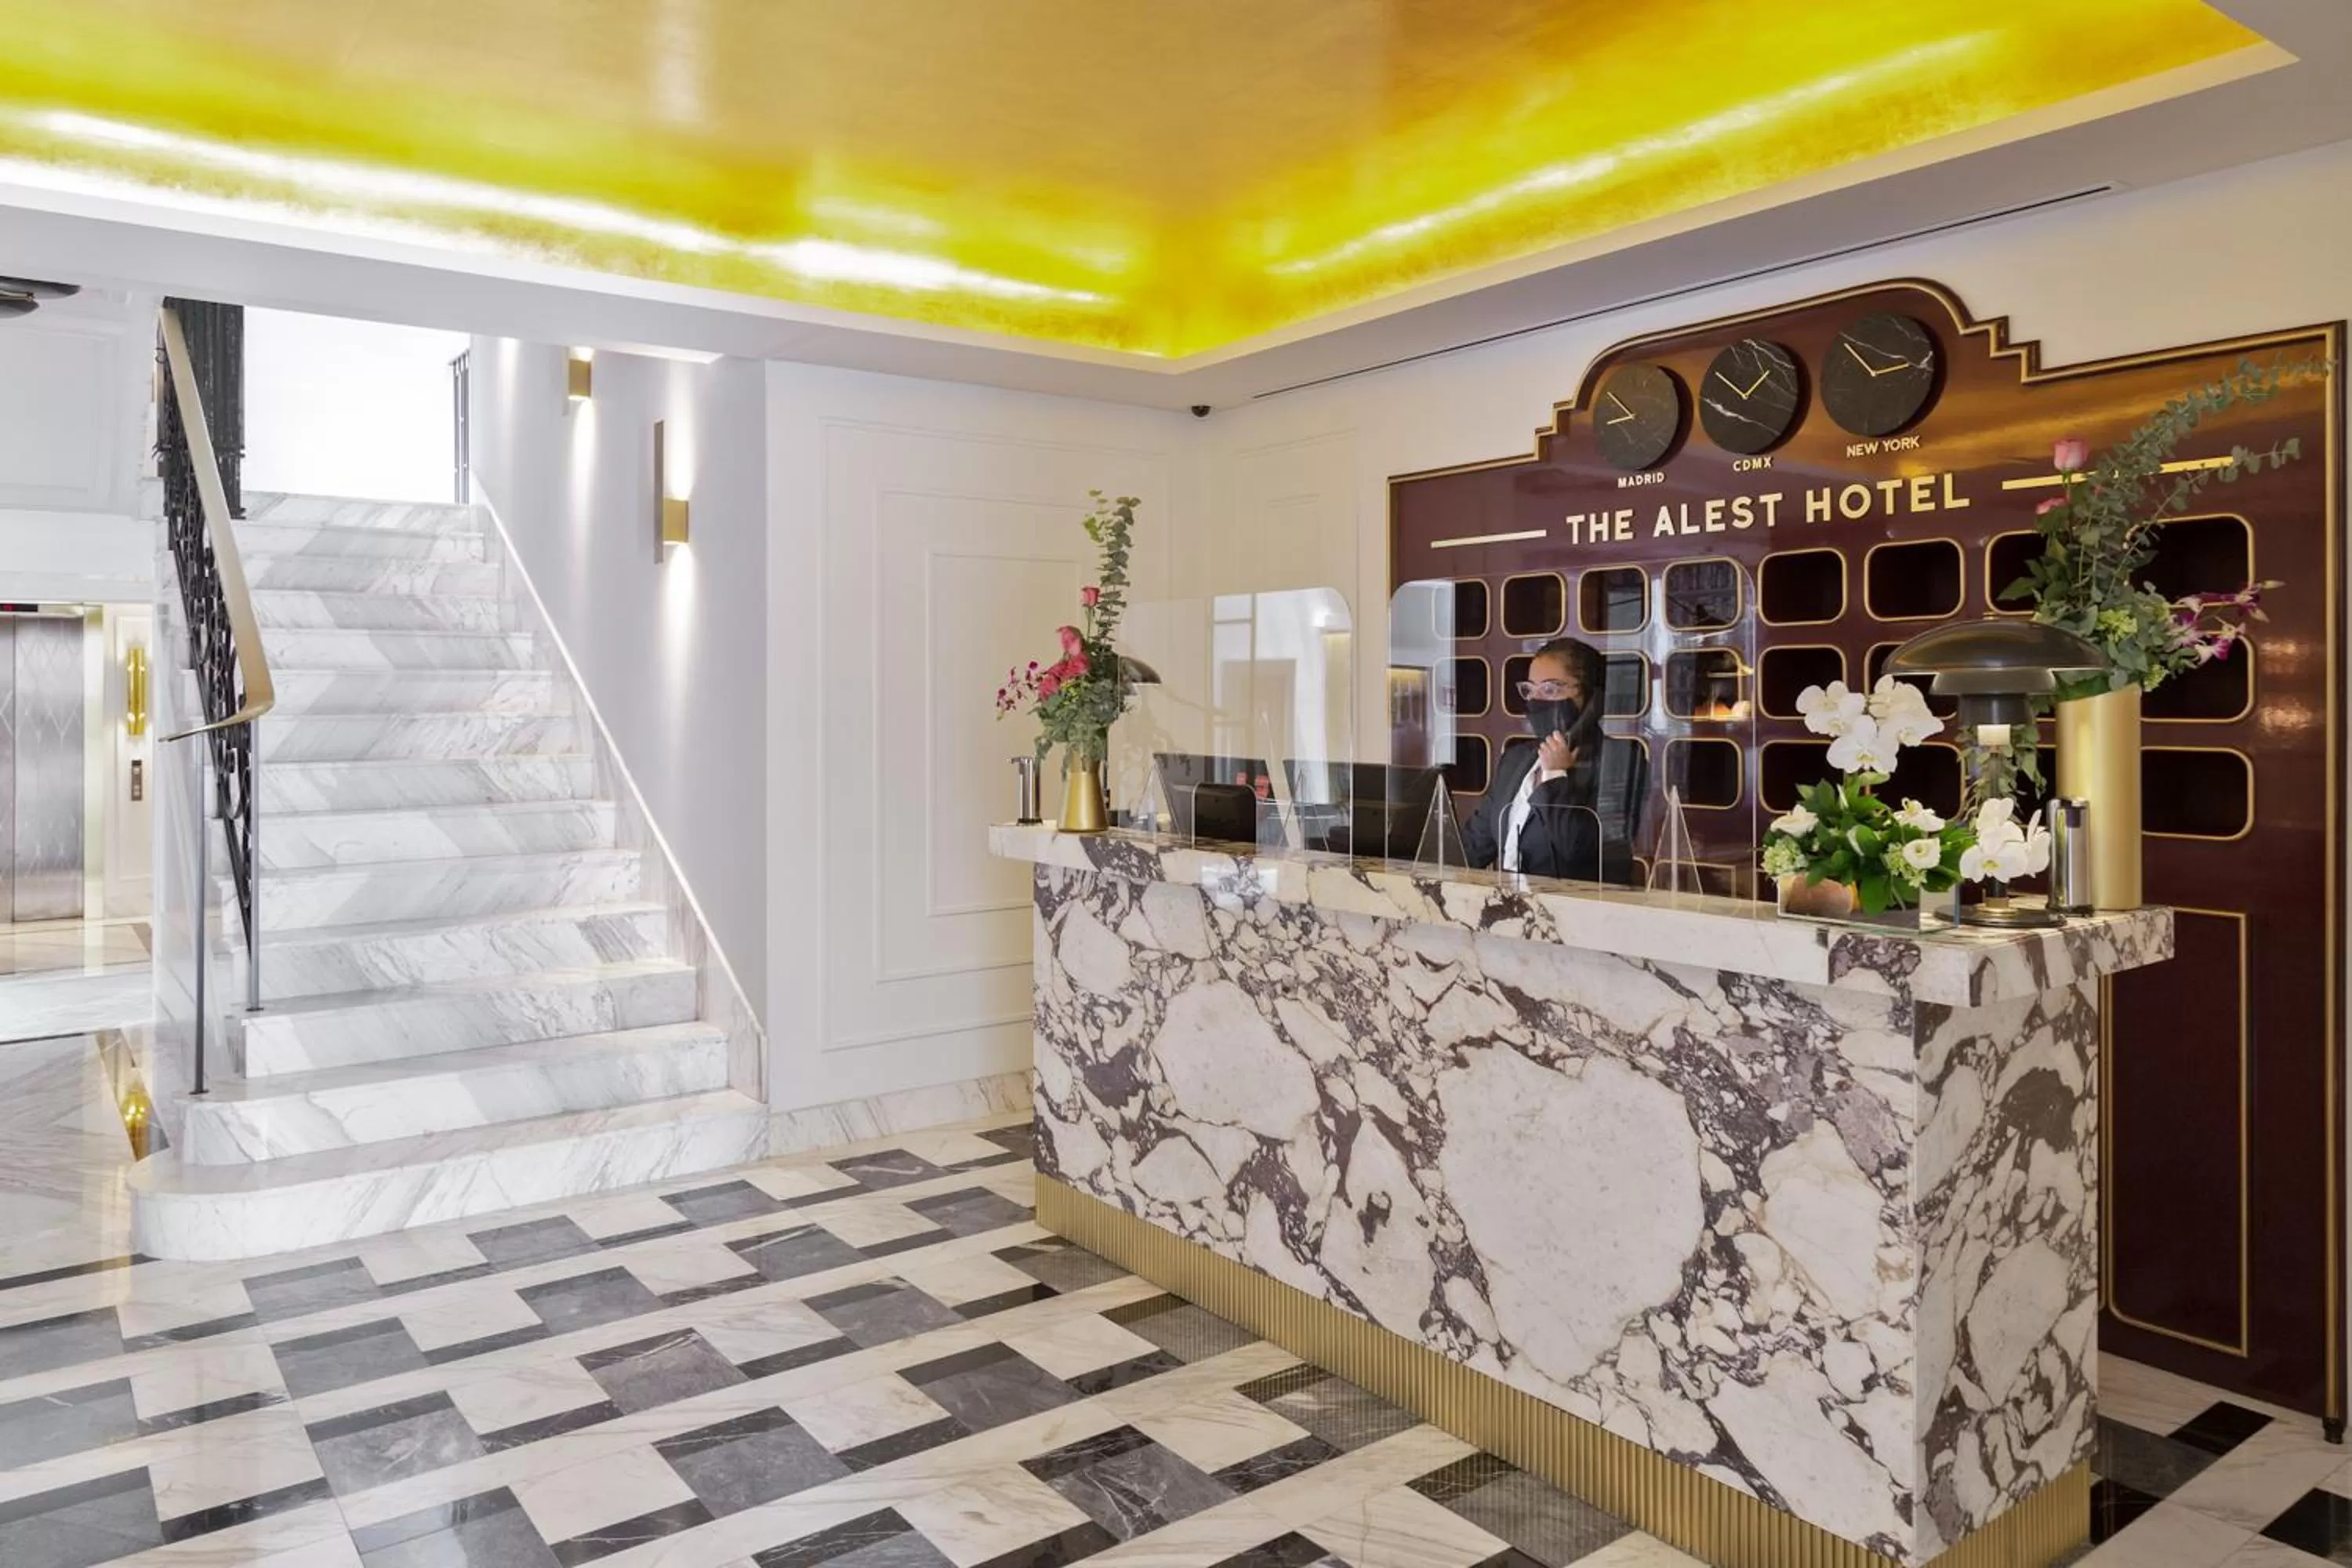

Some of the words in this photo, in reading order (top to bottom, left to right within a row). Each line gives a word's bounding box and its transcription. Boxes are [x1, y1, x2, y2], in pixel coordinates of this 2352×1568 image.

[1846, 441, 1878, 458] NEW
[1882, 436, 1920, 452] YORK
[1733, 456, 1772, 472] CDMX
[1617, 471, 1665, 488] MADRID
[1566, 509, 1634, 545] THE
[1653, 492, 1783, 538] ALEST
[1806, 473, 1970, 524] HOTEL
